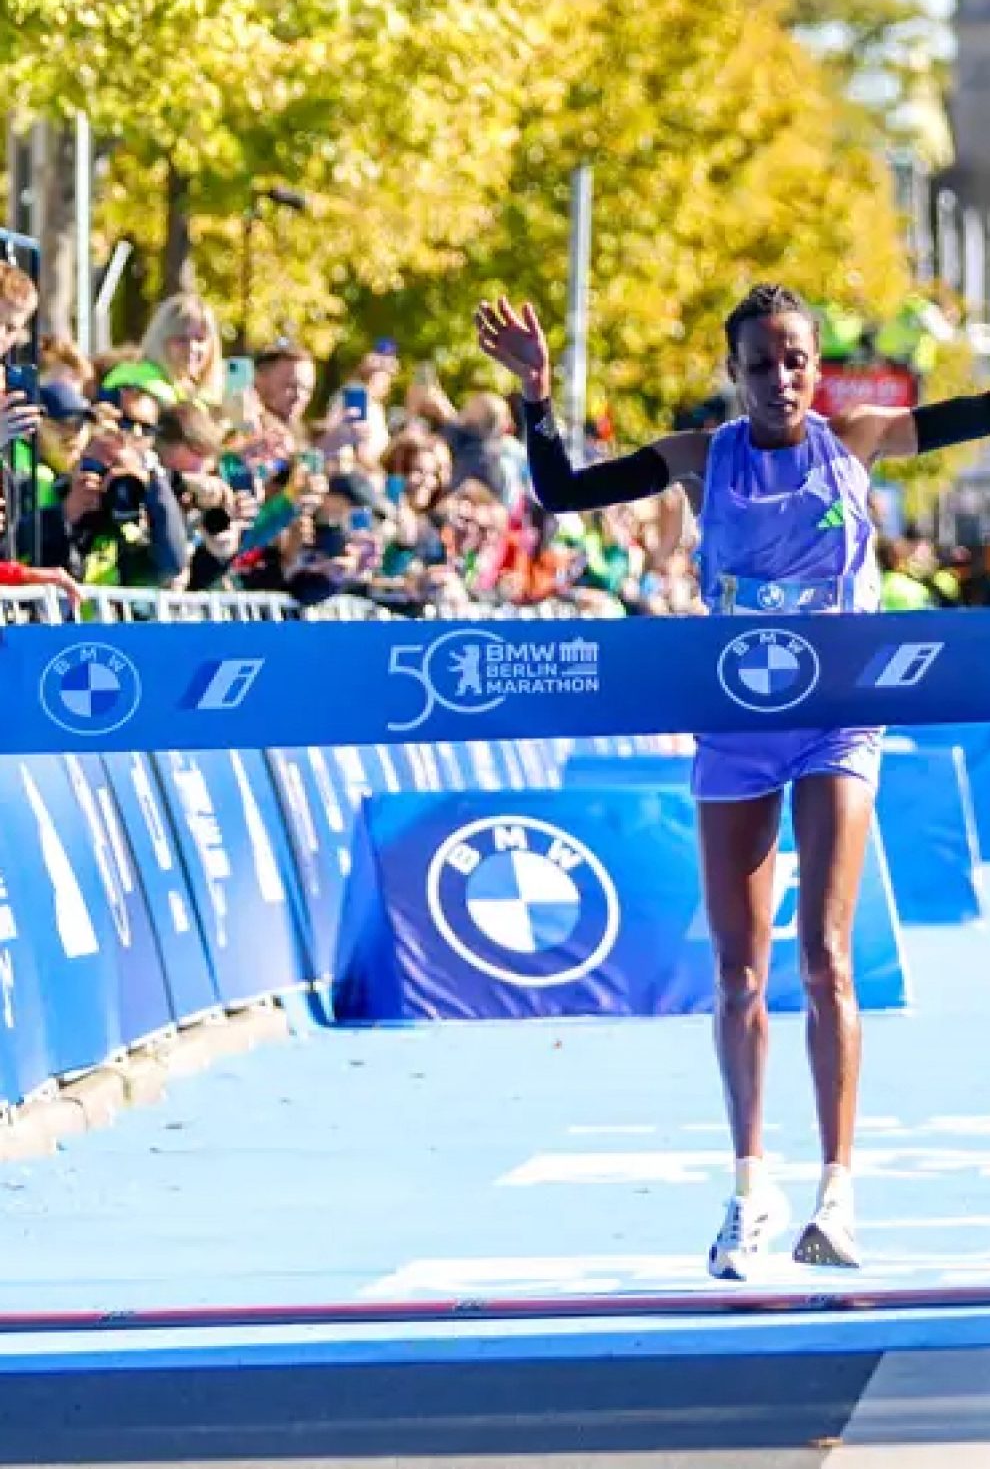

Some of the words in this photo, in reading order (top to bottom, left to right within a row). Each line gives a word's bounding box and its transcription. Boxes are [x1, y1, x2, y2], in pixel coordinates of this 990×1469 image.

[486, 643, 555, 662] BMW
[486, 662, 558, 678] BERLIN
[486, 677, 600, 694] MARATHON
[445, 824, 588, 876] BMW
